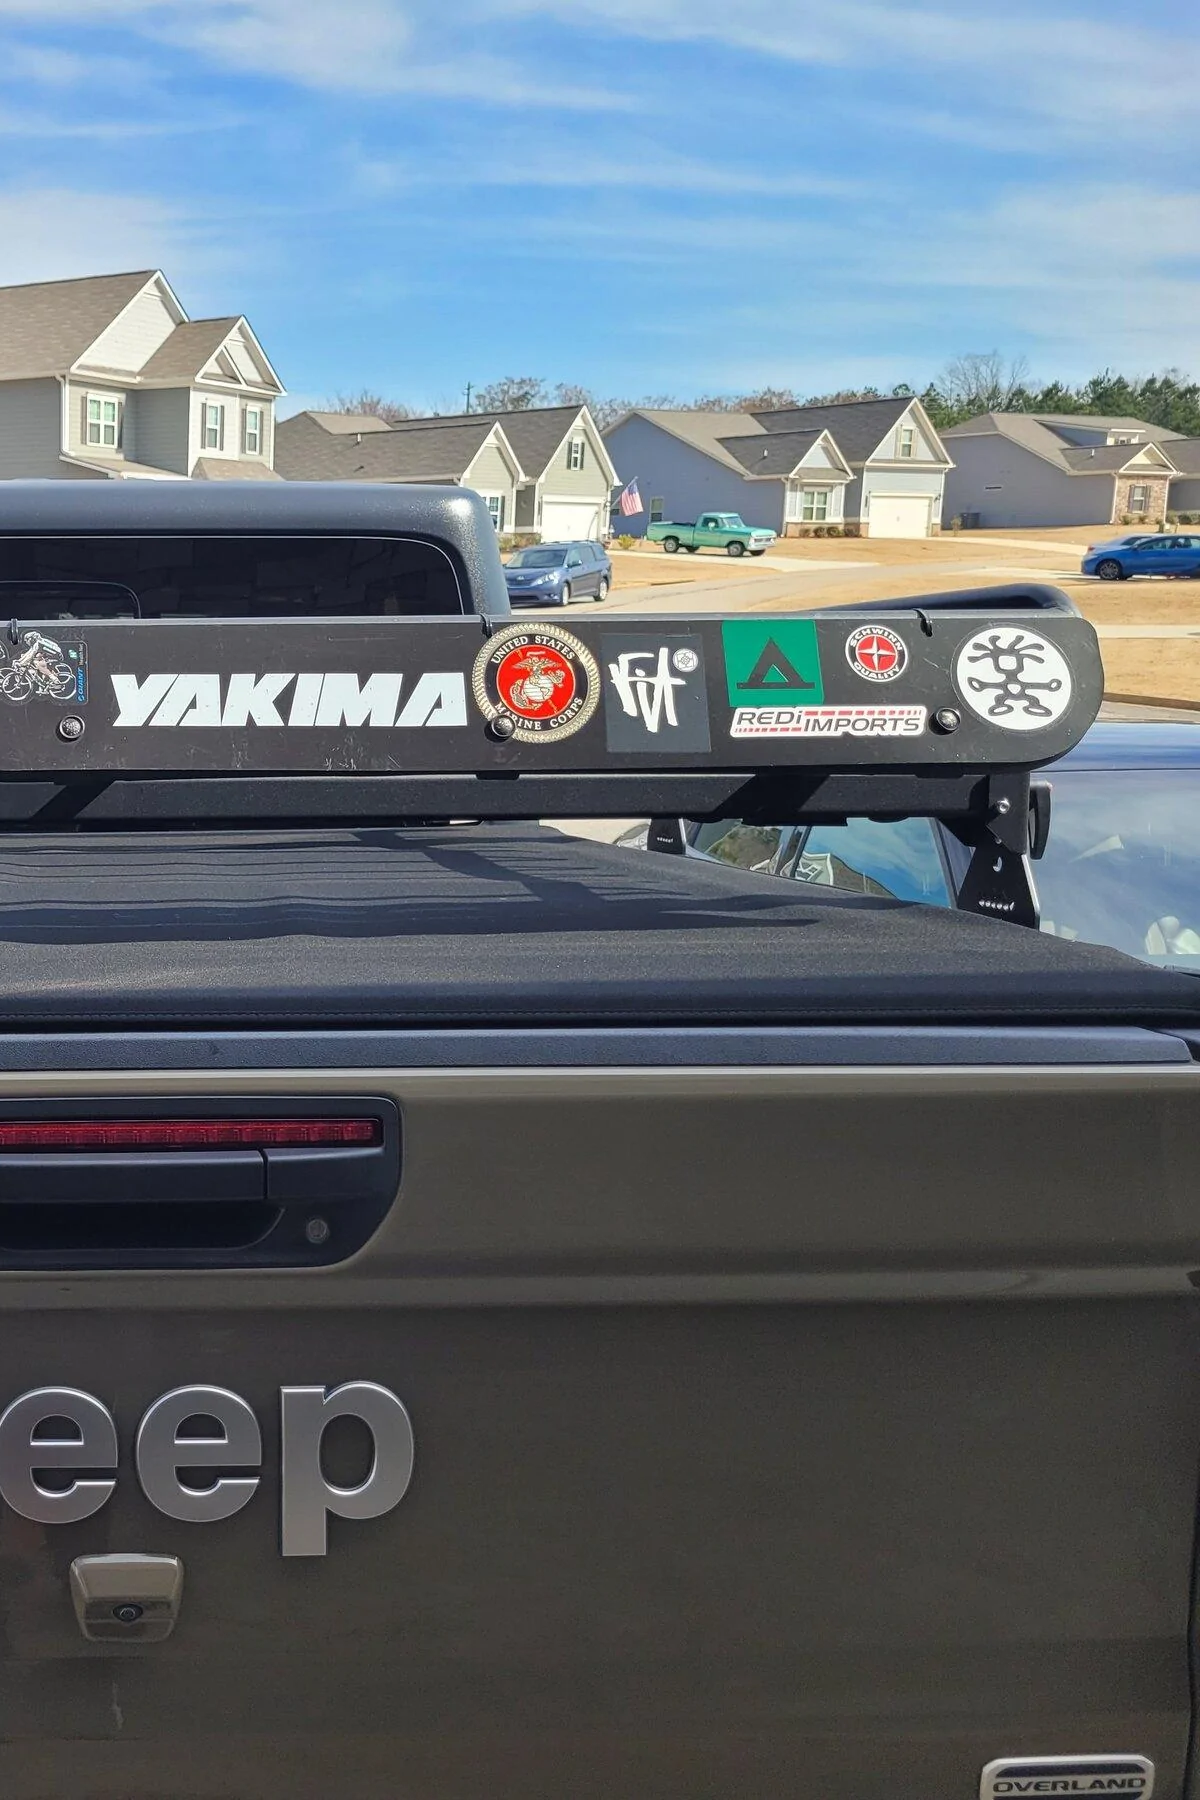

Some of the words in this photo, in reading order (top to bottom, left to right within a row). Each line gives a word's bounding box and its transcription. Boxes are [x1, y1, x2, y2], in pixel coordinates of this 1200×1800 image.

[491, 635, 529, 664] UNITED
[535, 635, 576, 660] STATES
[849, 628, 903, 651] SCHWINN
[77, 666, 85, 695] GIANT
[853, 661, 900, 679] QUALITY
[110, 672, 468, 727] YAKIMA
[494, 703, 542, 731] MARINE
[549, 697, 583, 728] CORPS
[803, 717, 920, 732] IMPORTS
[992, 1777, 1147, 1793] OVERLAND
